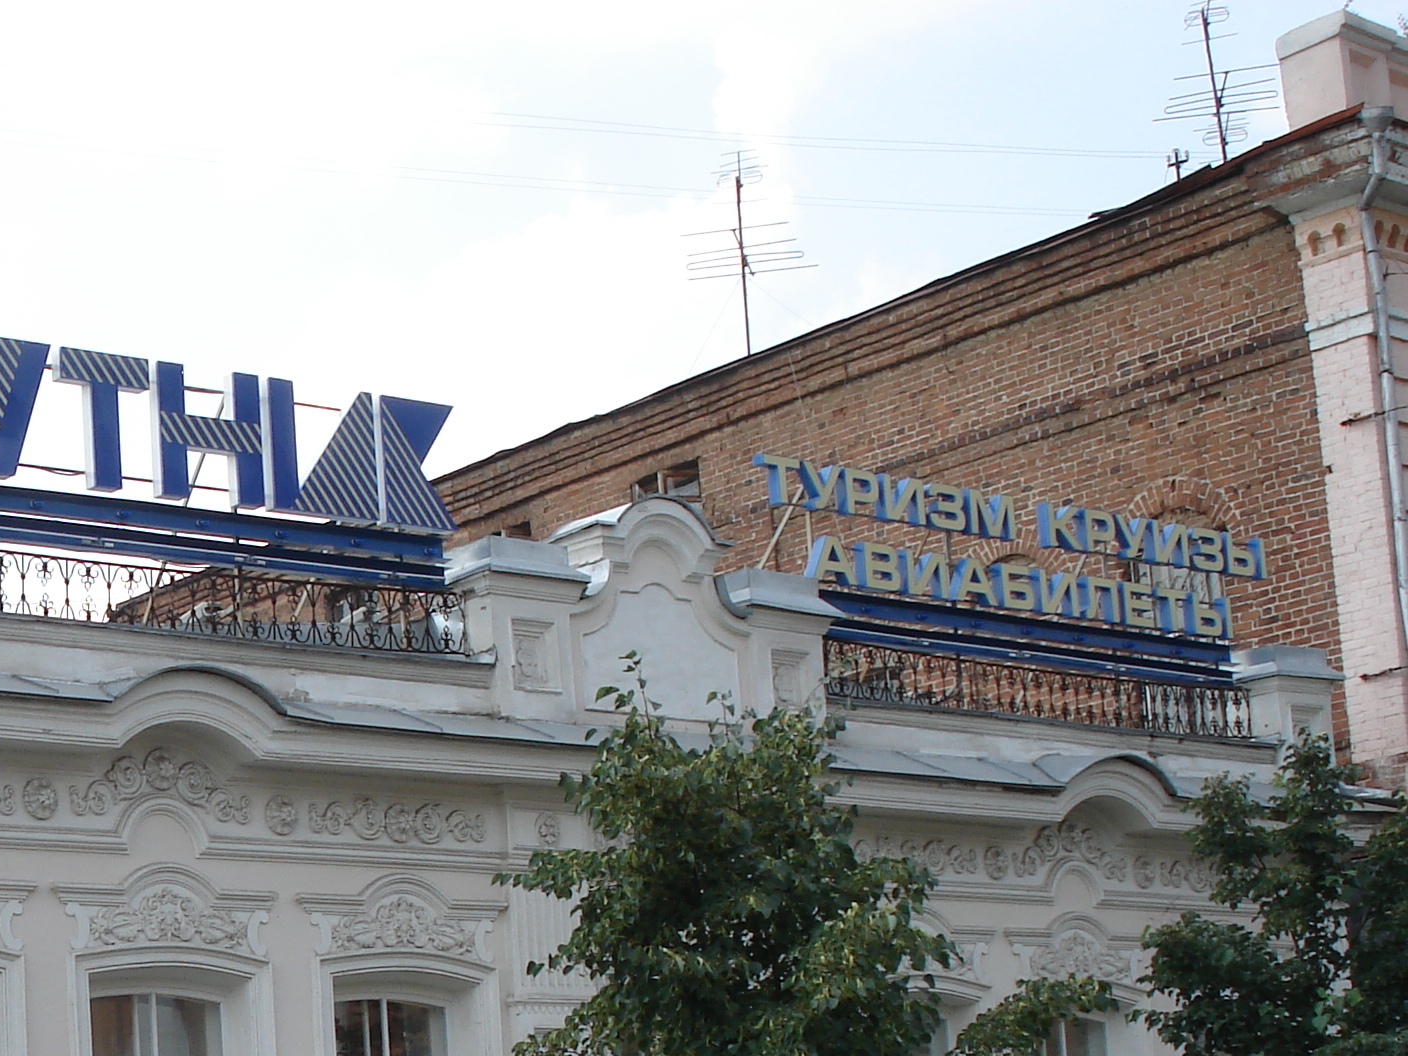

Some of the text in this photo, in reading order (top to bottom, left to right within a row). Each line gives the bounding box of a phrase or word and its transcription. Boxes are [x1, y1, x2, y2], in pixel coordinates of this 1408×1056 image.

[752, 452, 1269, 580] ТУРИЗМ КРУИЗЫ
[803, 534, 1234, 640] АВИАБИЛЕТЫ
